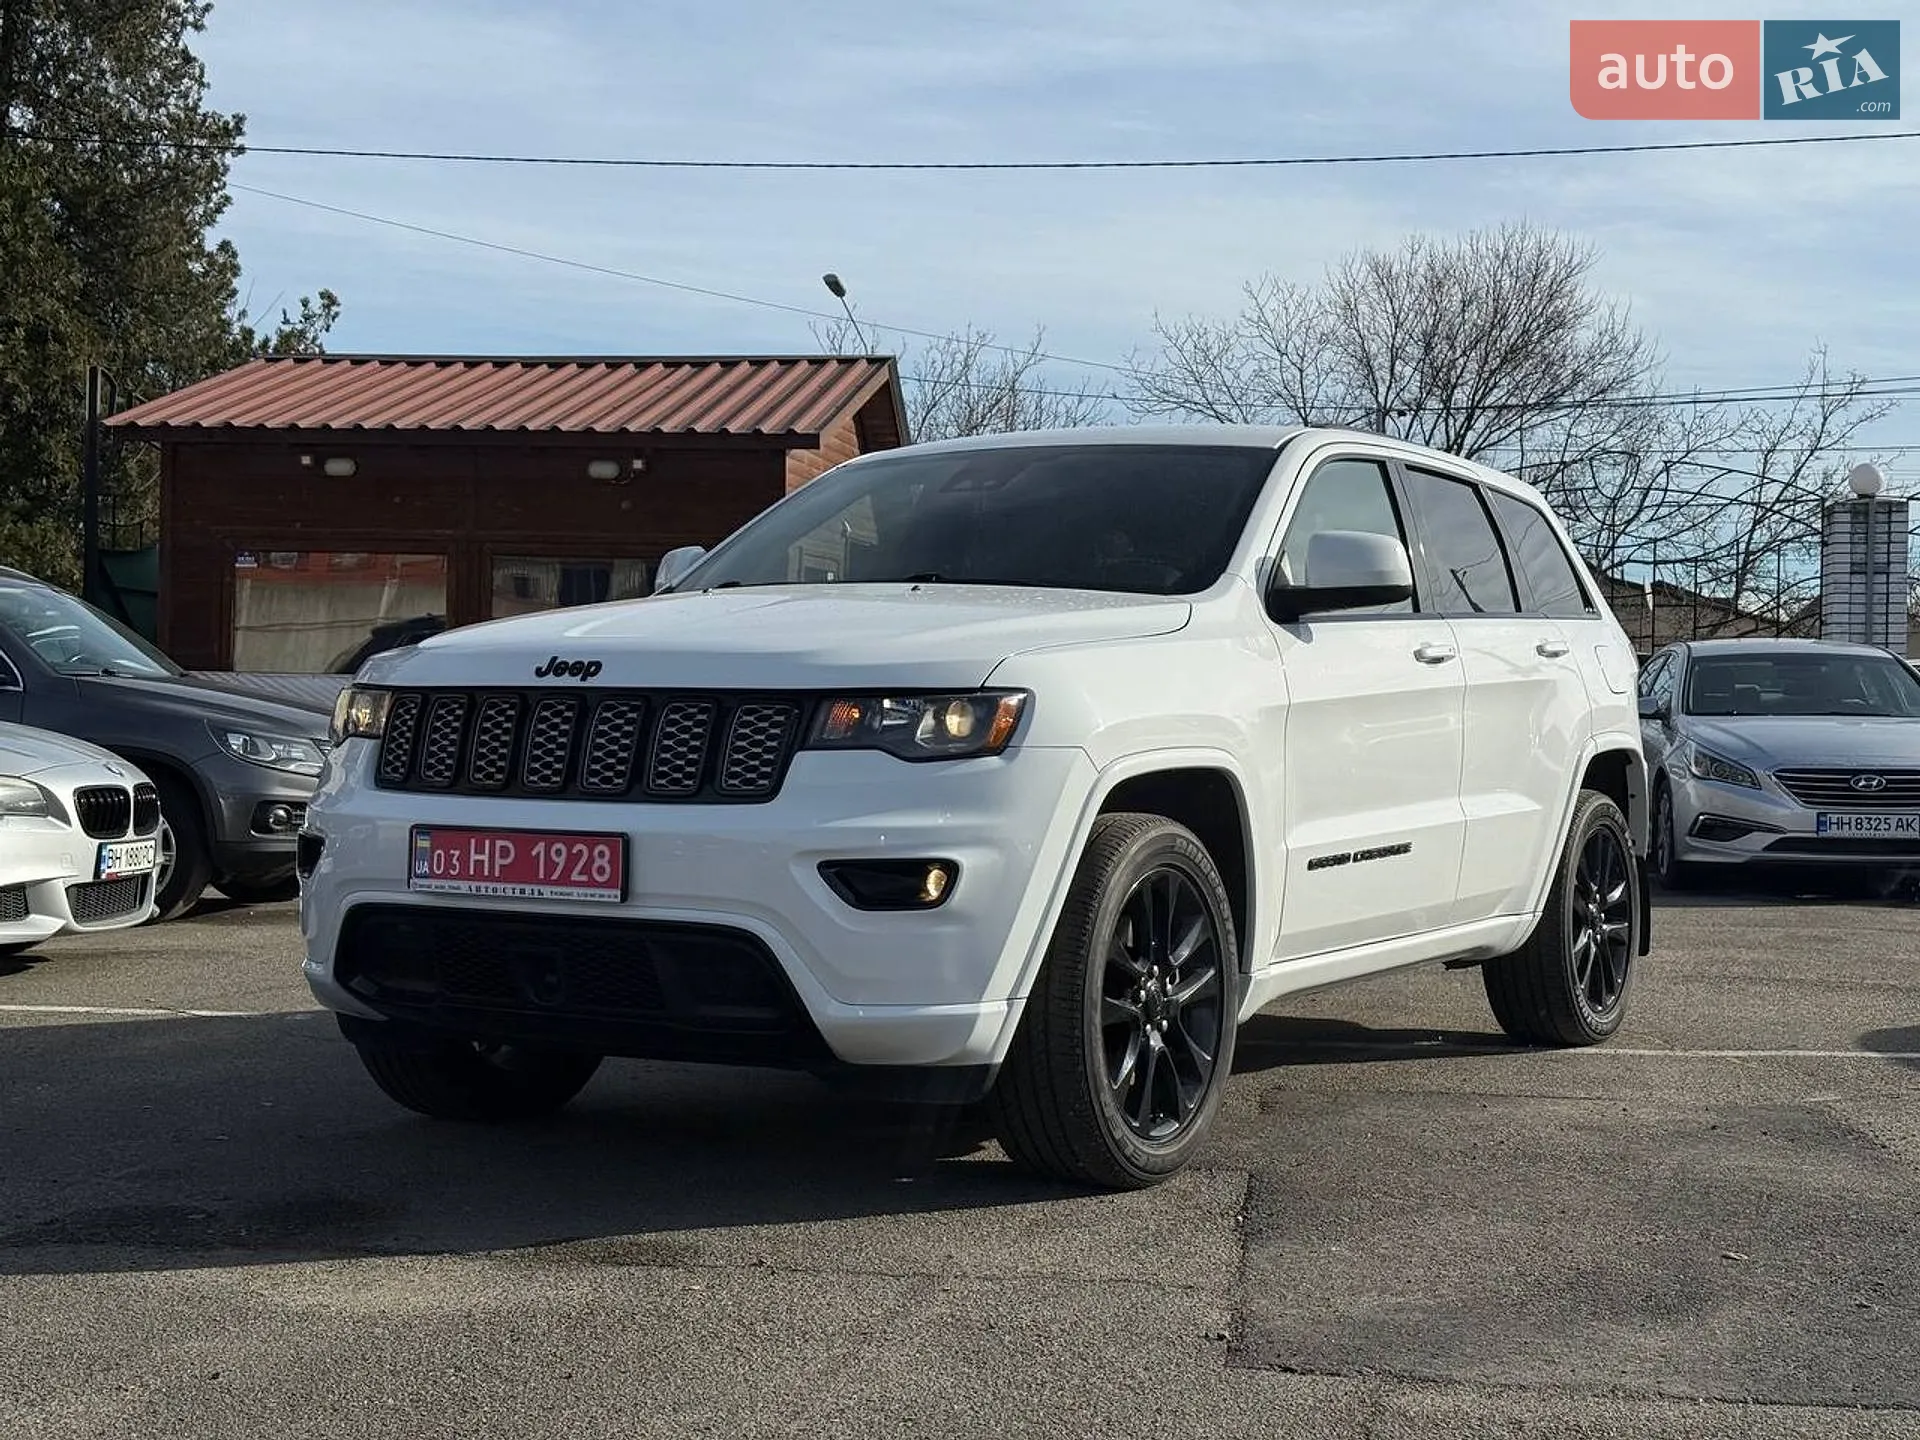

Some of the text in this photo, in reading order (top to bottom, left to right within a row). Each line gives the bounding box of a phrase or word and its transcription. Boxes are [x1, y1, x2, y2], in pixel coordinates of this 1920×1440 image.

[535, 655, 602, 682] Jeep
[1829, 816, 1917, 832] HH 8325 AK
[415, 860, 430, 874] UA
[469, 838, 516, 877] HP
[531, 841, 611, 882] 1928
